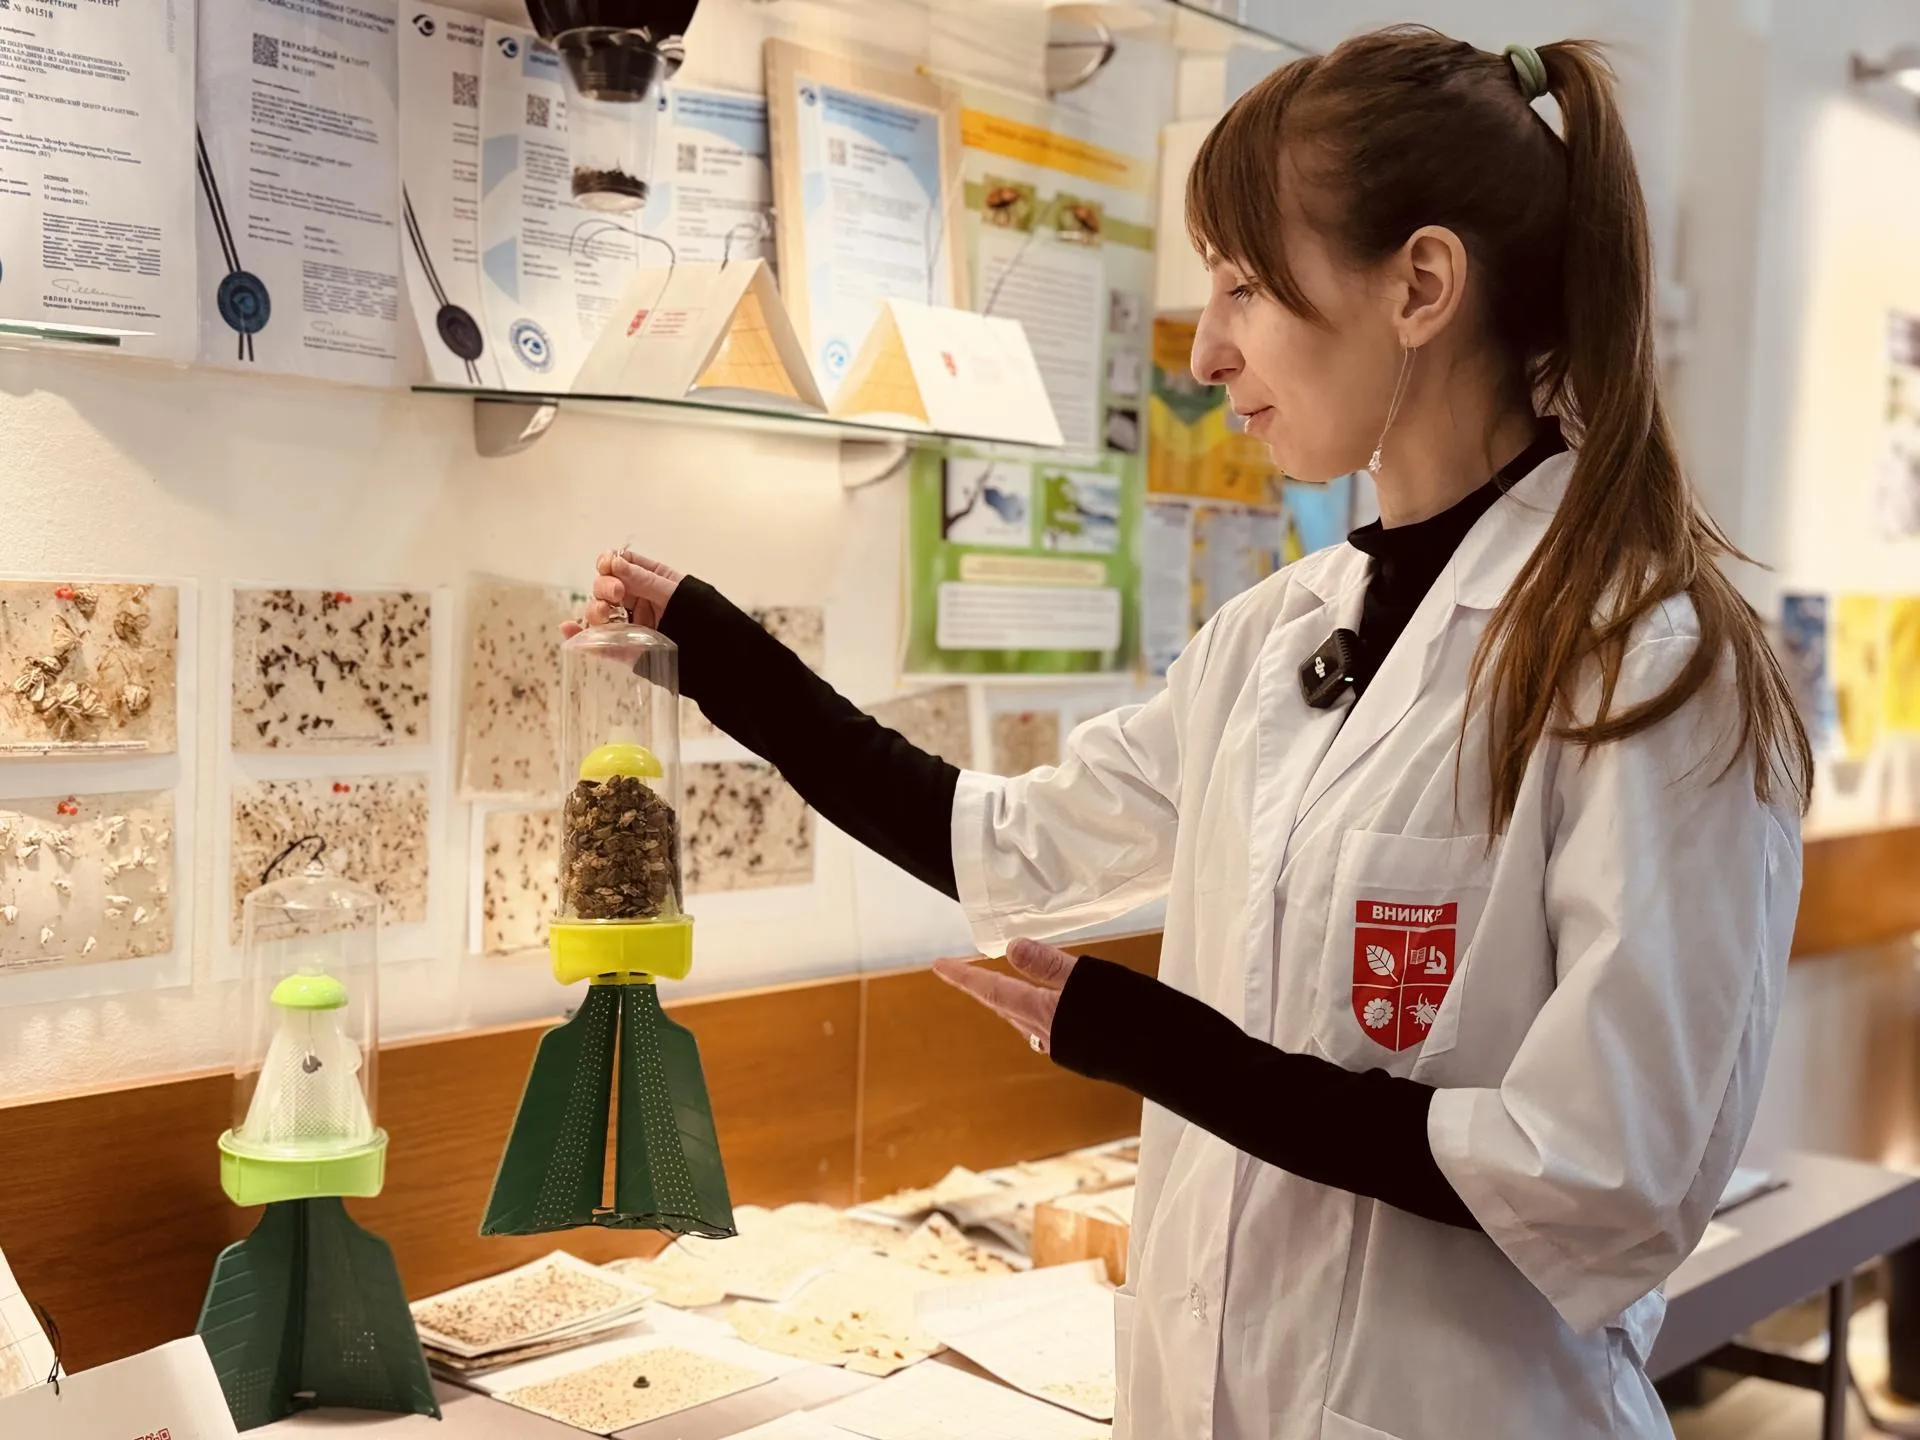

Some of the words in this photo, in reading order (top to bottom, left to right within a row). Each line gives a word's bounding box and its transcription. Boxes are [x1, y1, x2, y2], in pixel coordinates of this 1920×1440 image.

[25, 6, 53, 18] 041518
[281, 40, 339, 61] ЕВРАЗИЙСКИЙ
[1372, 905, 1443, 923] ВНИИКР
